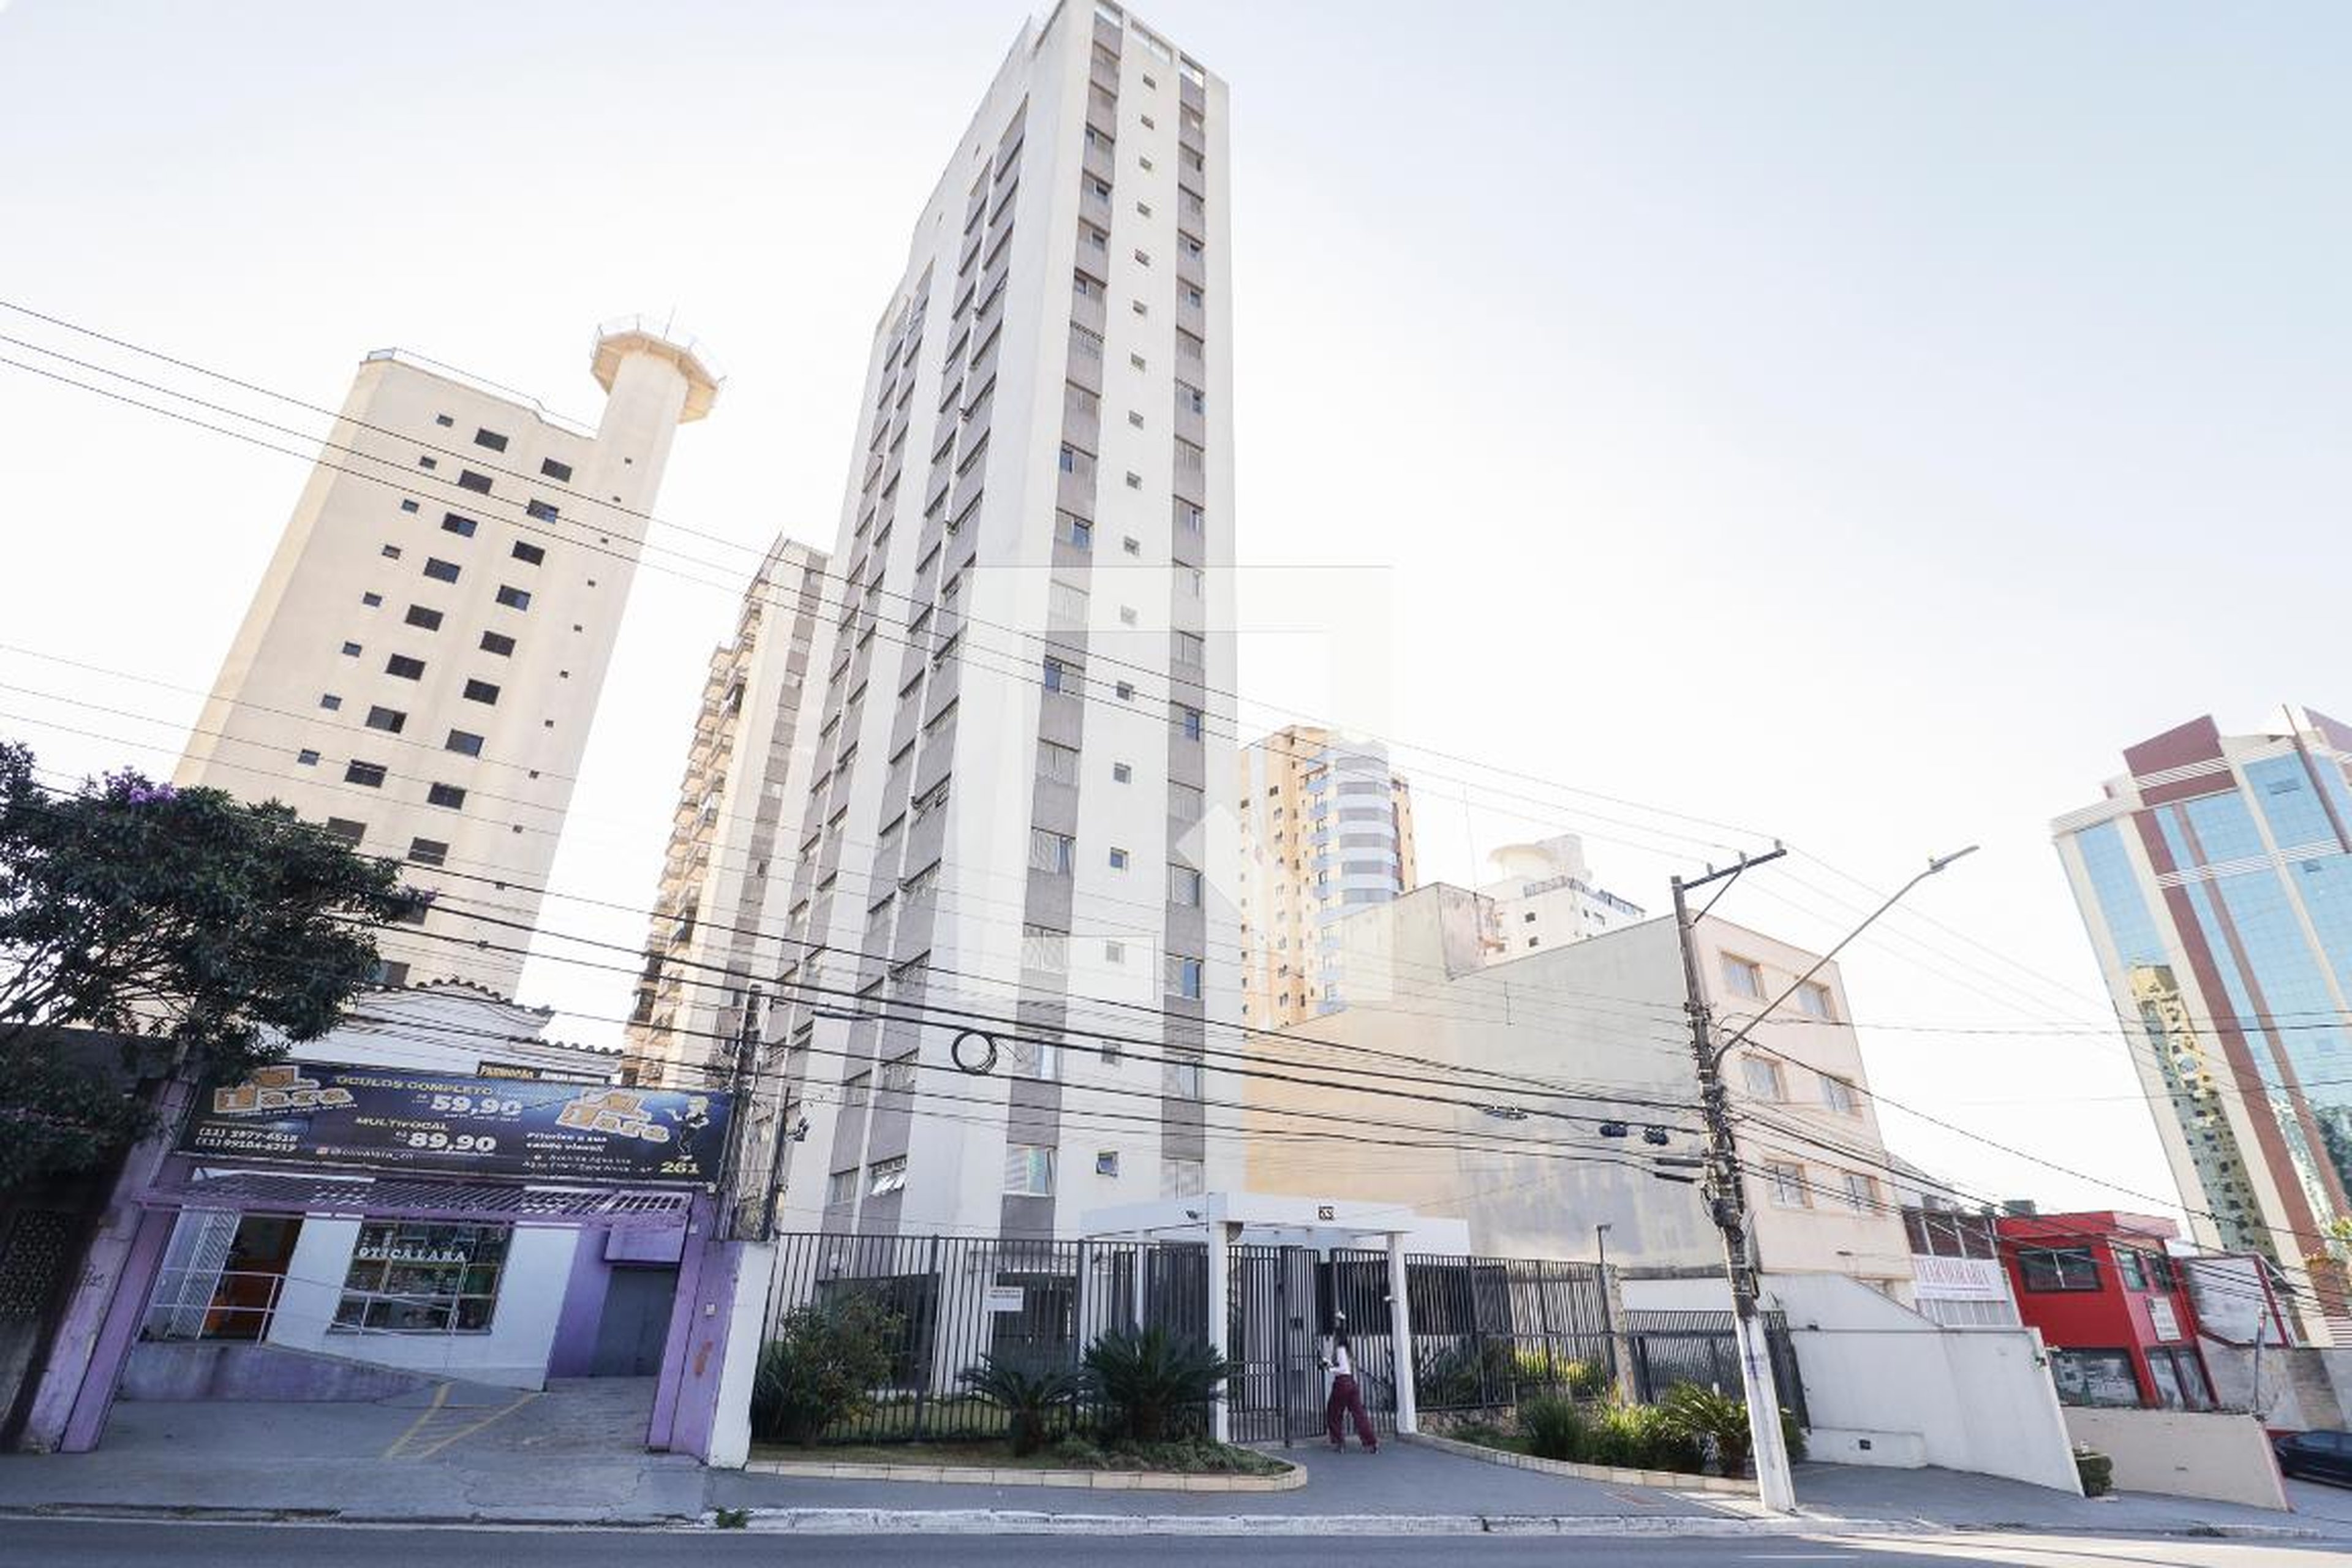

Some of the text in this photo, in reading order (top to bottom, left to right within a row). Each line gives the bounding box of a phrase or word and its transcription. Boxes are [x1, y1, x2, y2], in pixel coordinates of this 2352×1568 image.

[431, 1095, 522, 1115] 59,90
[356, 1117, 450, 1131] MULTIFOCAL
[408, 1133, 496, 1152] 89,90
[660, 1161, 700, 1174] 261
